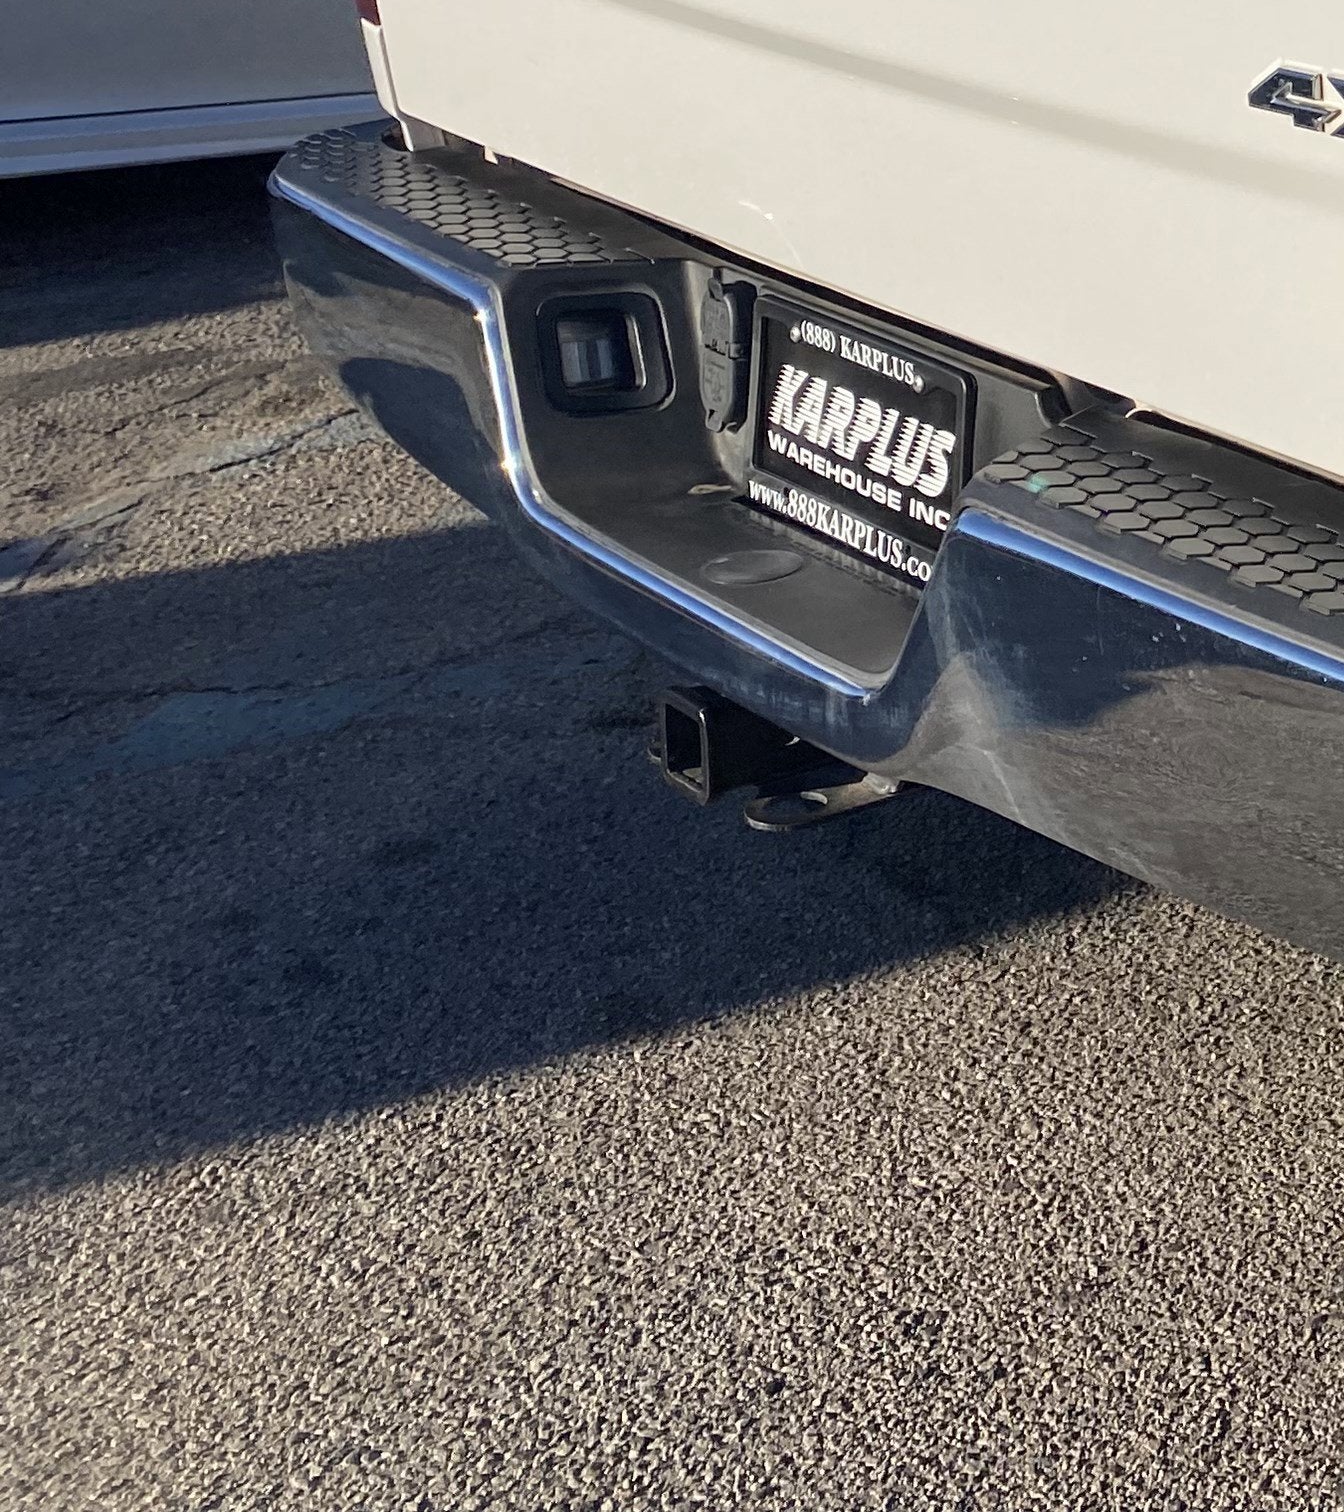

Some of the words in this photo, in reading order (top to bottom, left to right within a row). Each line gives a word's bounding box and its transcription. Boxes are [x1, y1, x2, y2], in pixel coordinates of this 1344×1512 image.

[801, 320, 836, 353] (888)
[839, 335, 915, 386] KARPLUS
[767, 364, 956, 498] KARPLUS
[767, 429, 902, 512] WAREHOUSE
[909, 498, 951, 531] INC
[748, 480, 932, 582] www.888KARPLUS.co
